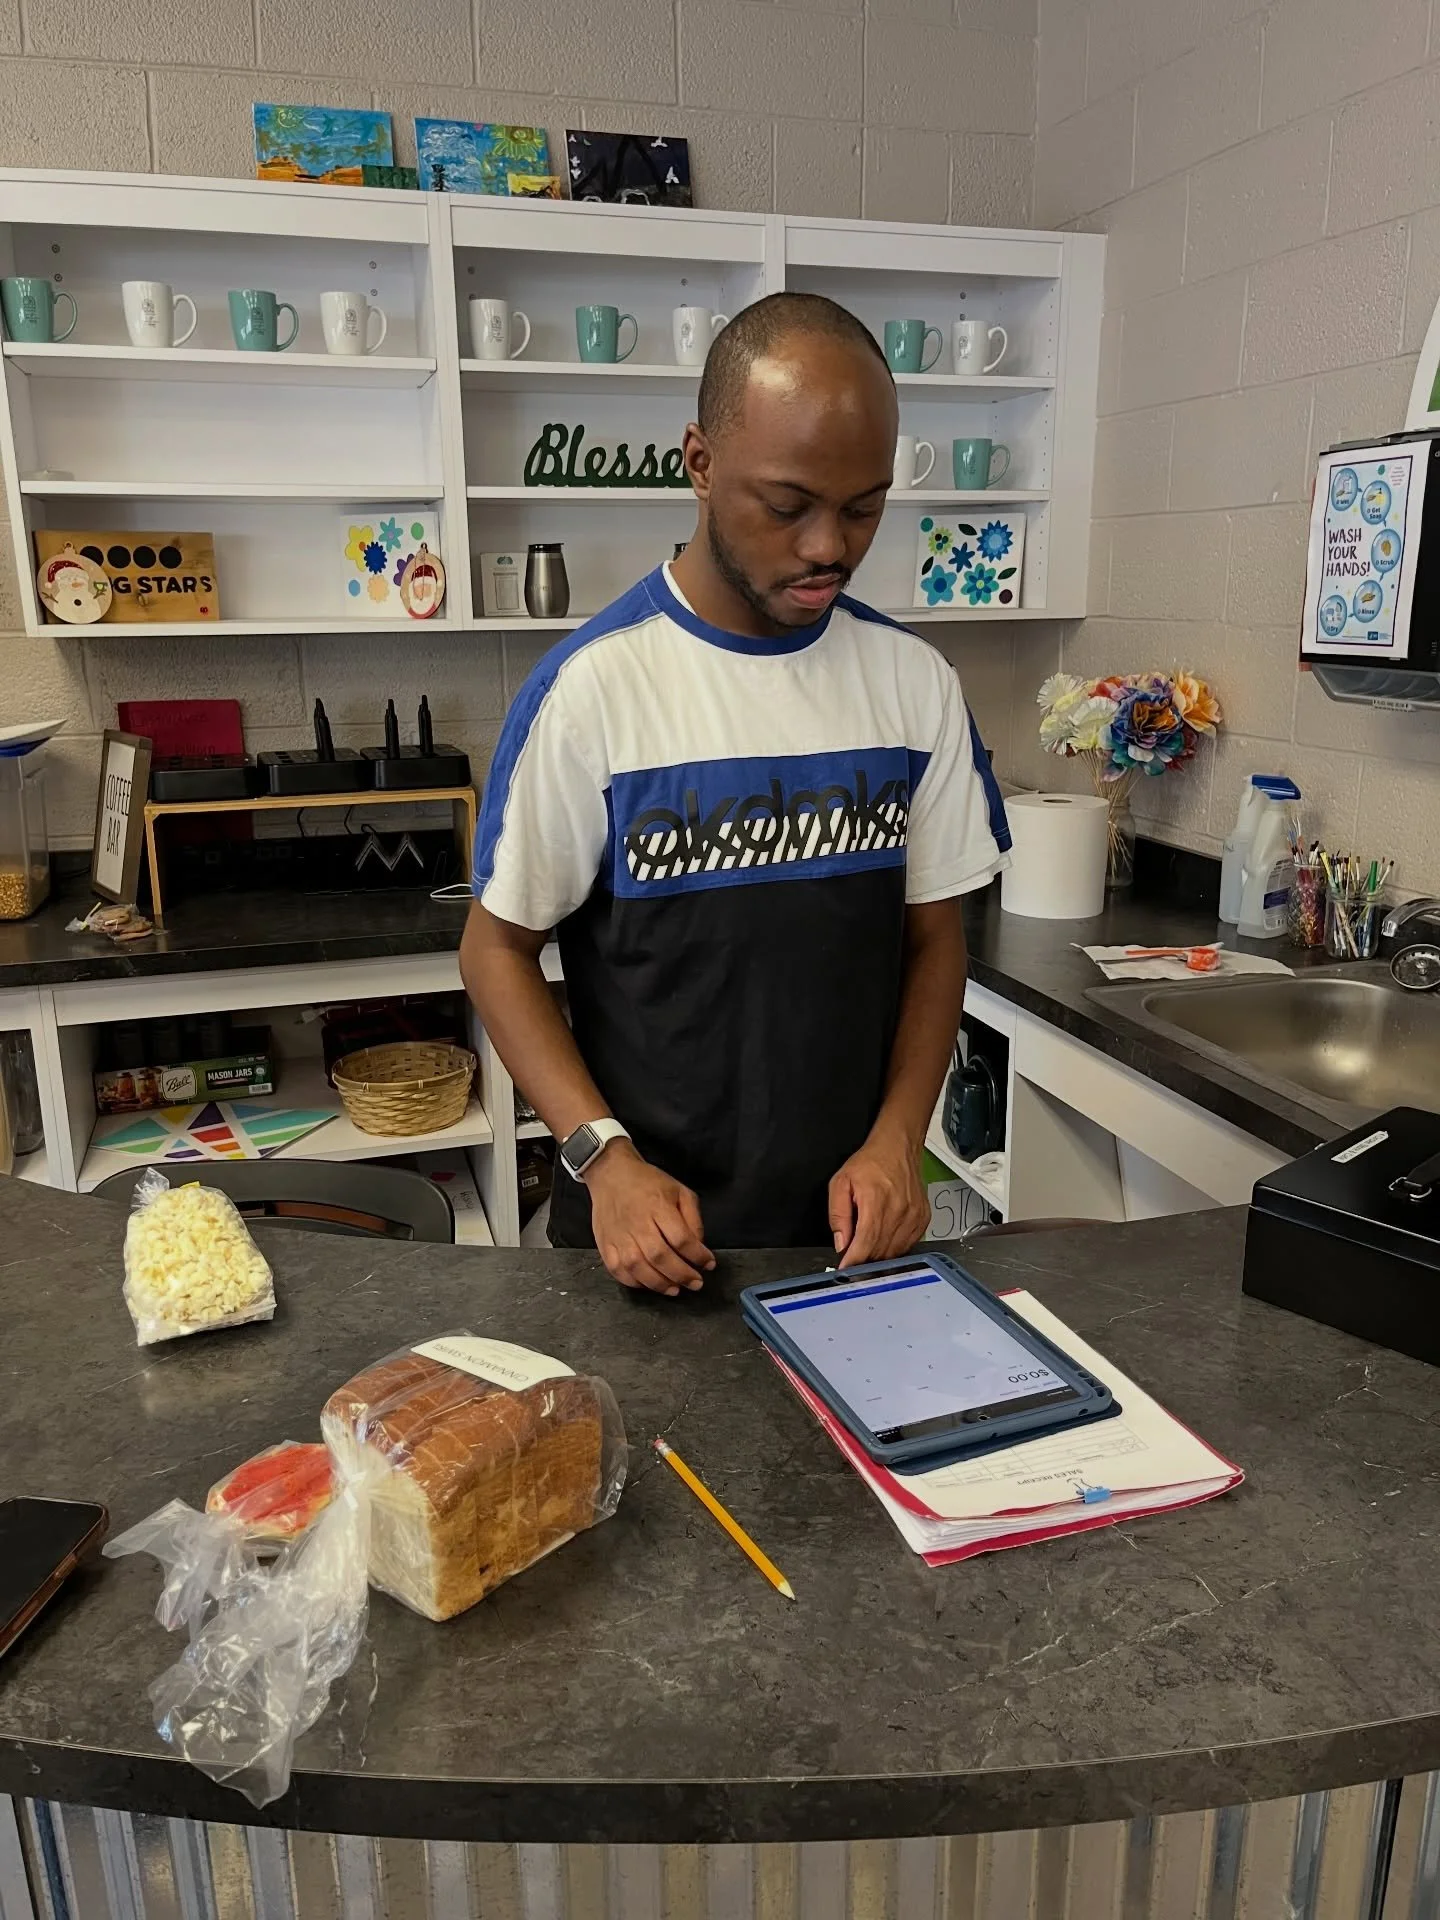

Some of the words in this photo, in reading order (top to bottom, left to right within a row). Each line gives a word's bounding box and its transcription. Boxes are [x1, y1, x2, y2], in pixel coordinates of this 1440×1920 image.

[524, 423, 691, 487] Blesse
[1329, 528, 1362, 544] WASH
[1328, 546, 1357, 561] YOUR
[1326, 561, 1370, 577] HANDS!
[137, 576, 212, 594] STARS
[106, 774, 132, 817] COFFEE
[106, 817, 121, 857] BAR
[165, 1073, 192, 1092] Ball
[207, 1070, 234, 1082] MASON
[234, 1067, 253, 1077] JARS
[931, 1186, 991, 1238] STO
[1007, 1369, 1049, 1384] $0.00
[1016, 1475, 1054, 1486] RECEIPT
[1053, 1469, 1084, 1479] SALES
